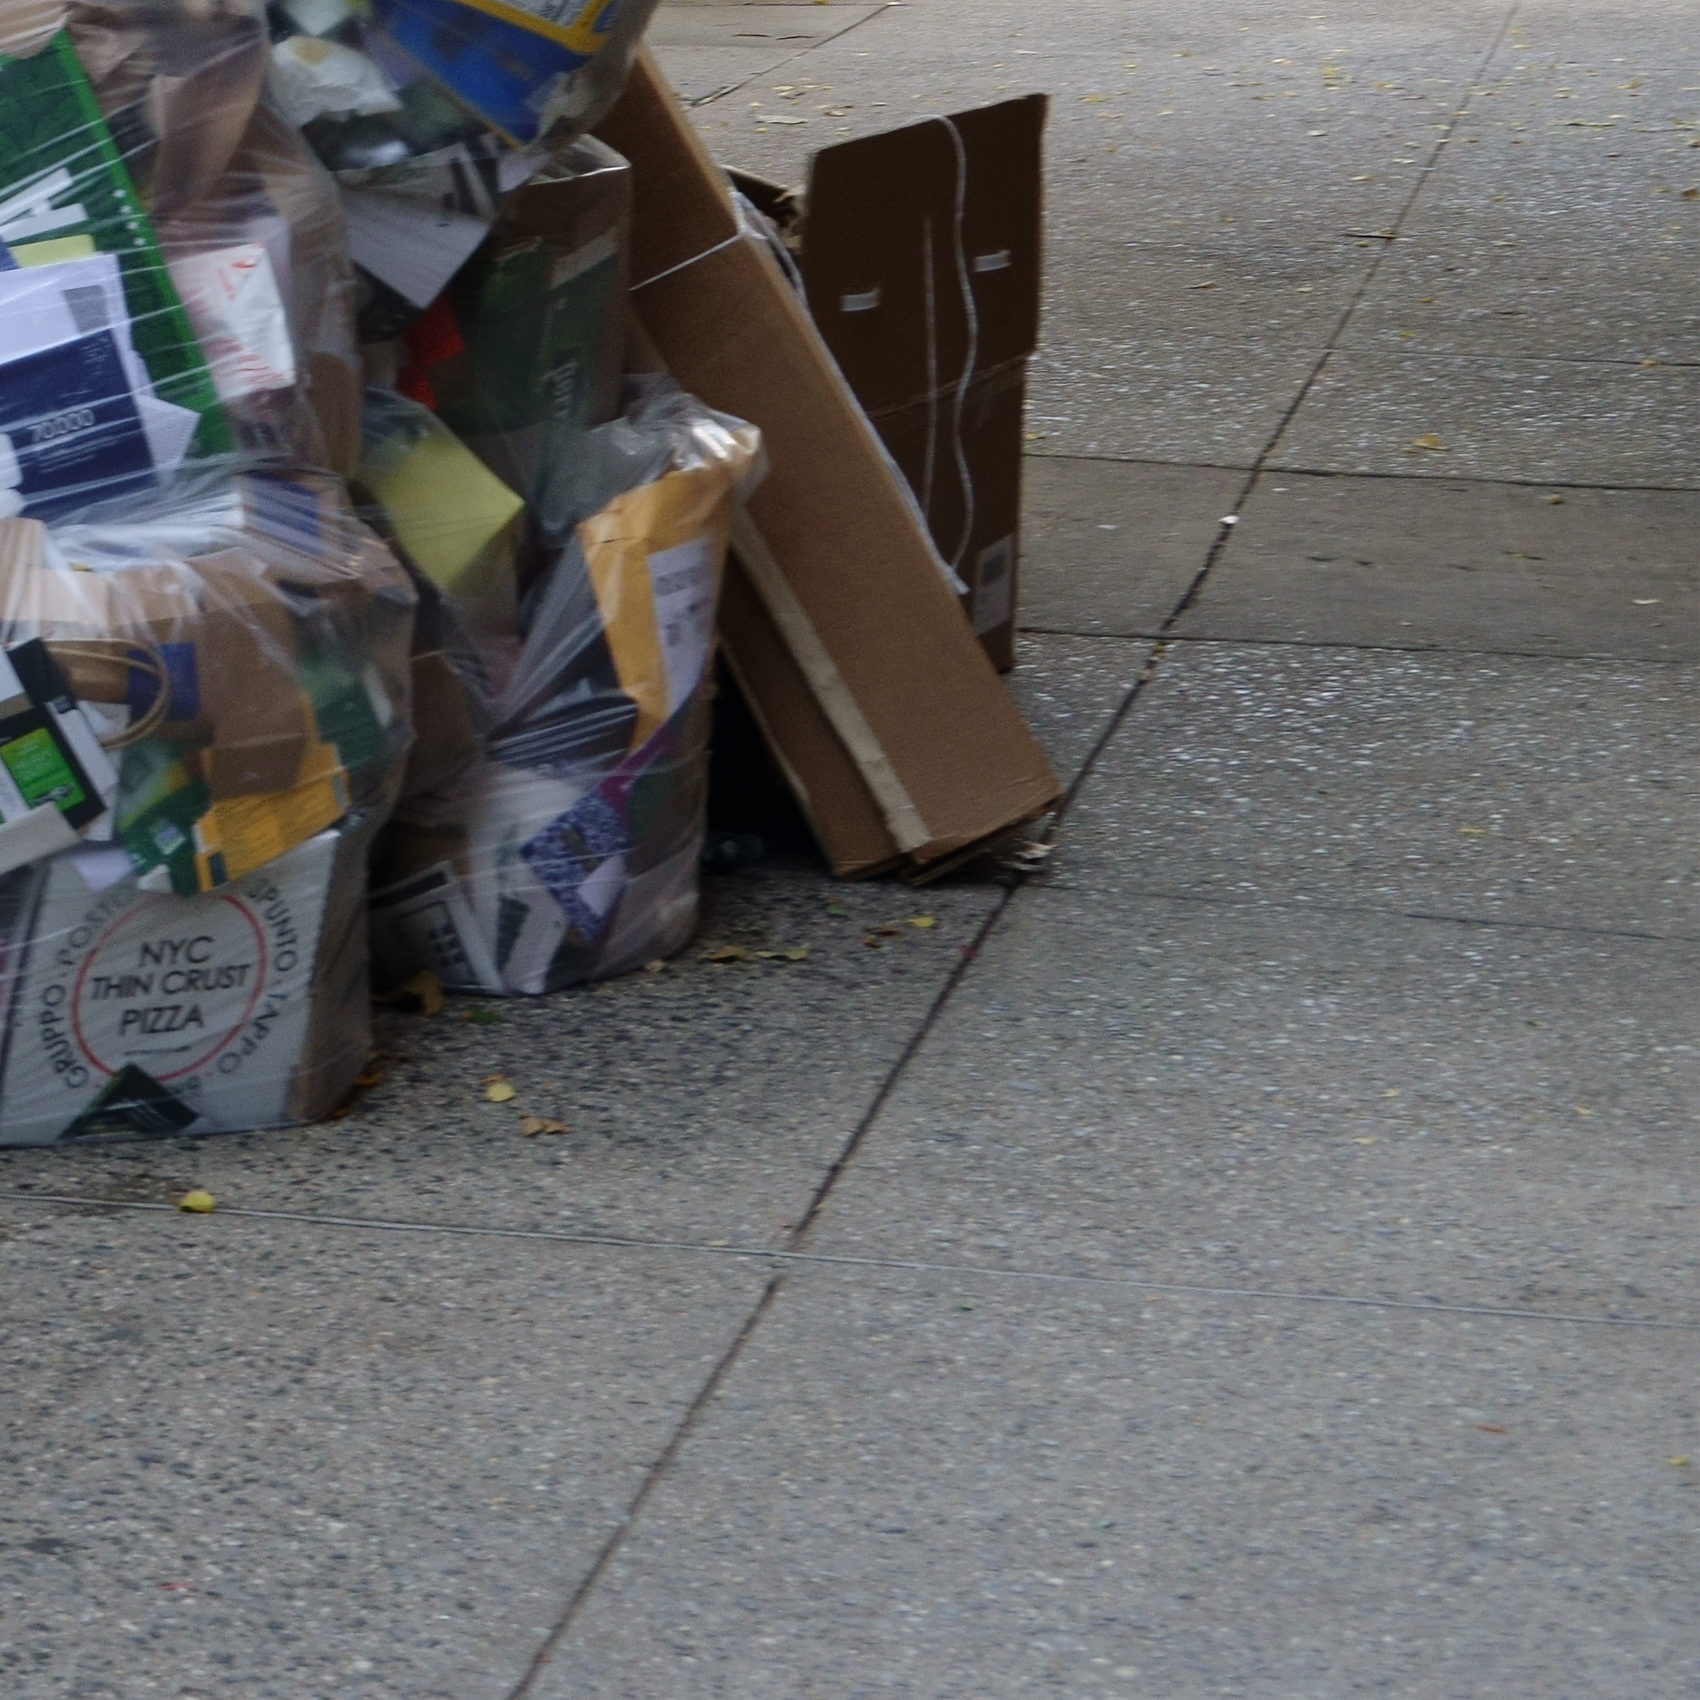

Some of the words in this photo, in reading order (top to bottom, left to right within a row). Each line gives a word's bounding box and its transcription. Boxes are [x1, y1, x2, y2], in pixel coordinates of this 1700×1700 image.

[139, 935, 216, 969] NYC
[249, 878, 298, 973] SPUNTO
[90, 972, 155, 1001] THIN
[161, 964, 251, 996] CRUST
[38, 984, 89, 1089] GRUPPO
[118, 1004, 205, 1037] PIZZA
[216, 992, 289, 1075] TAPPO
